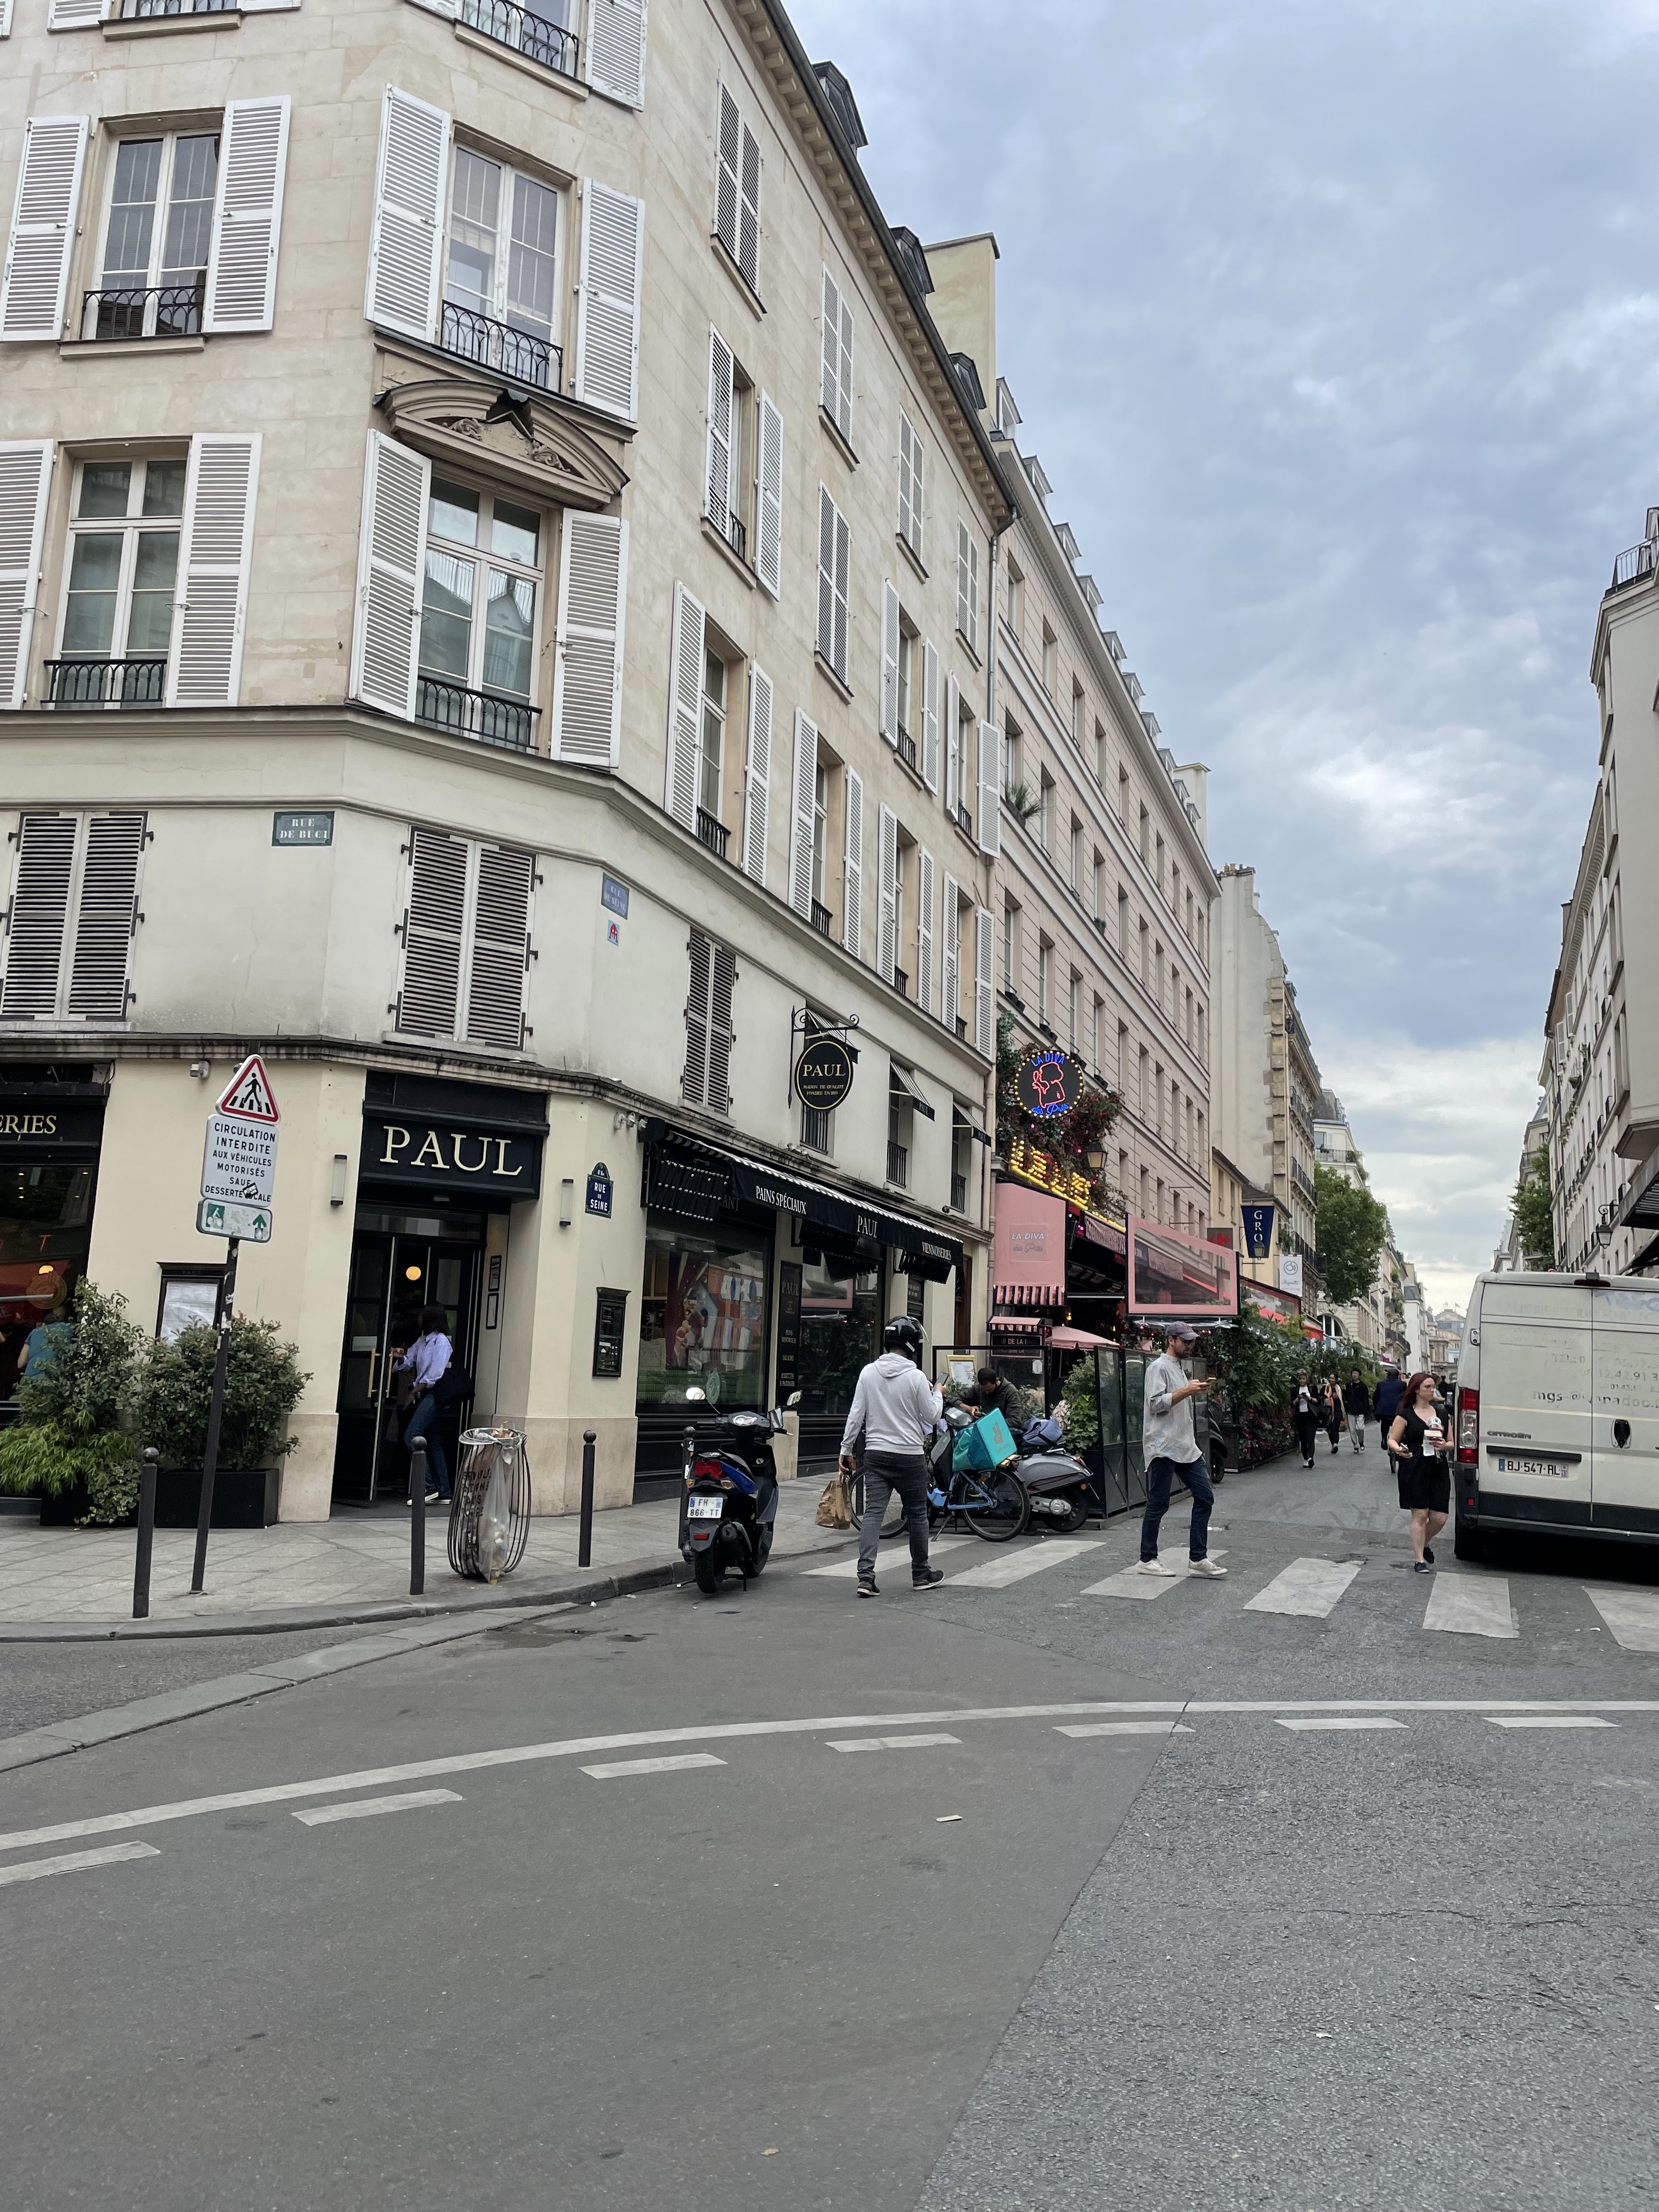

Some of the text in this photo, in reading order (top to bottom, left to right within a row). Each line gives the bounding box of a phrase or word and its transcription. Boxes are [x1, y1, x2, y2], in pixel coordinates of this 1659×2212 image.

[292, 818, 315, 827] RUE
[280, 830, 328, 839] DE BUCI
[610, 885, 621, 898] RUE
[612, 896, 626, 911] SEINE
[1031, 1053, 1065, 1066] LA DIVA
[803, 1064, 847, 1076] PAUL
[919, 1102, 929, 1115] PAUL
[215, 1122, 276, 1142] CIRCULATION
[216, 1136, 271, 1155] INTERDITE
[380, 1125, 522, 1176] PAUL
[212, 1150, 228, 1159] AUX
[217, 1162, 265, 1178] MOTORISÉS
[205, 1185, 271, 1203] DESSERTE CALE
[594, 1182, 606, 1193] RUE
[590, 1199, 608, 1211] SEINE
[755, 1185, 806, 1215] PAINS SPÉCIAUX
[857, 1215, 878, 1238] PAUL
[1254, 1210, 1263, 1243] GRO
